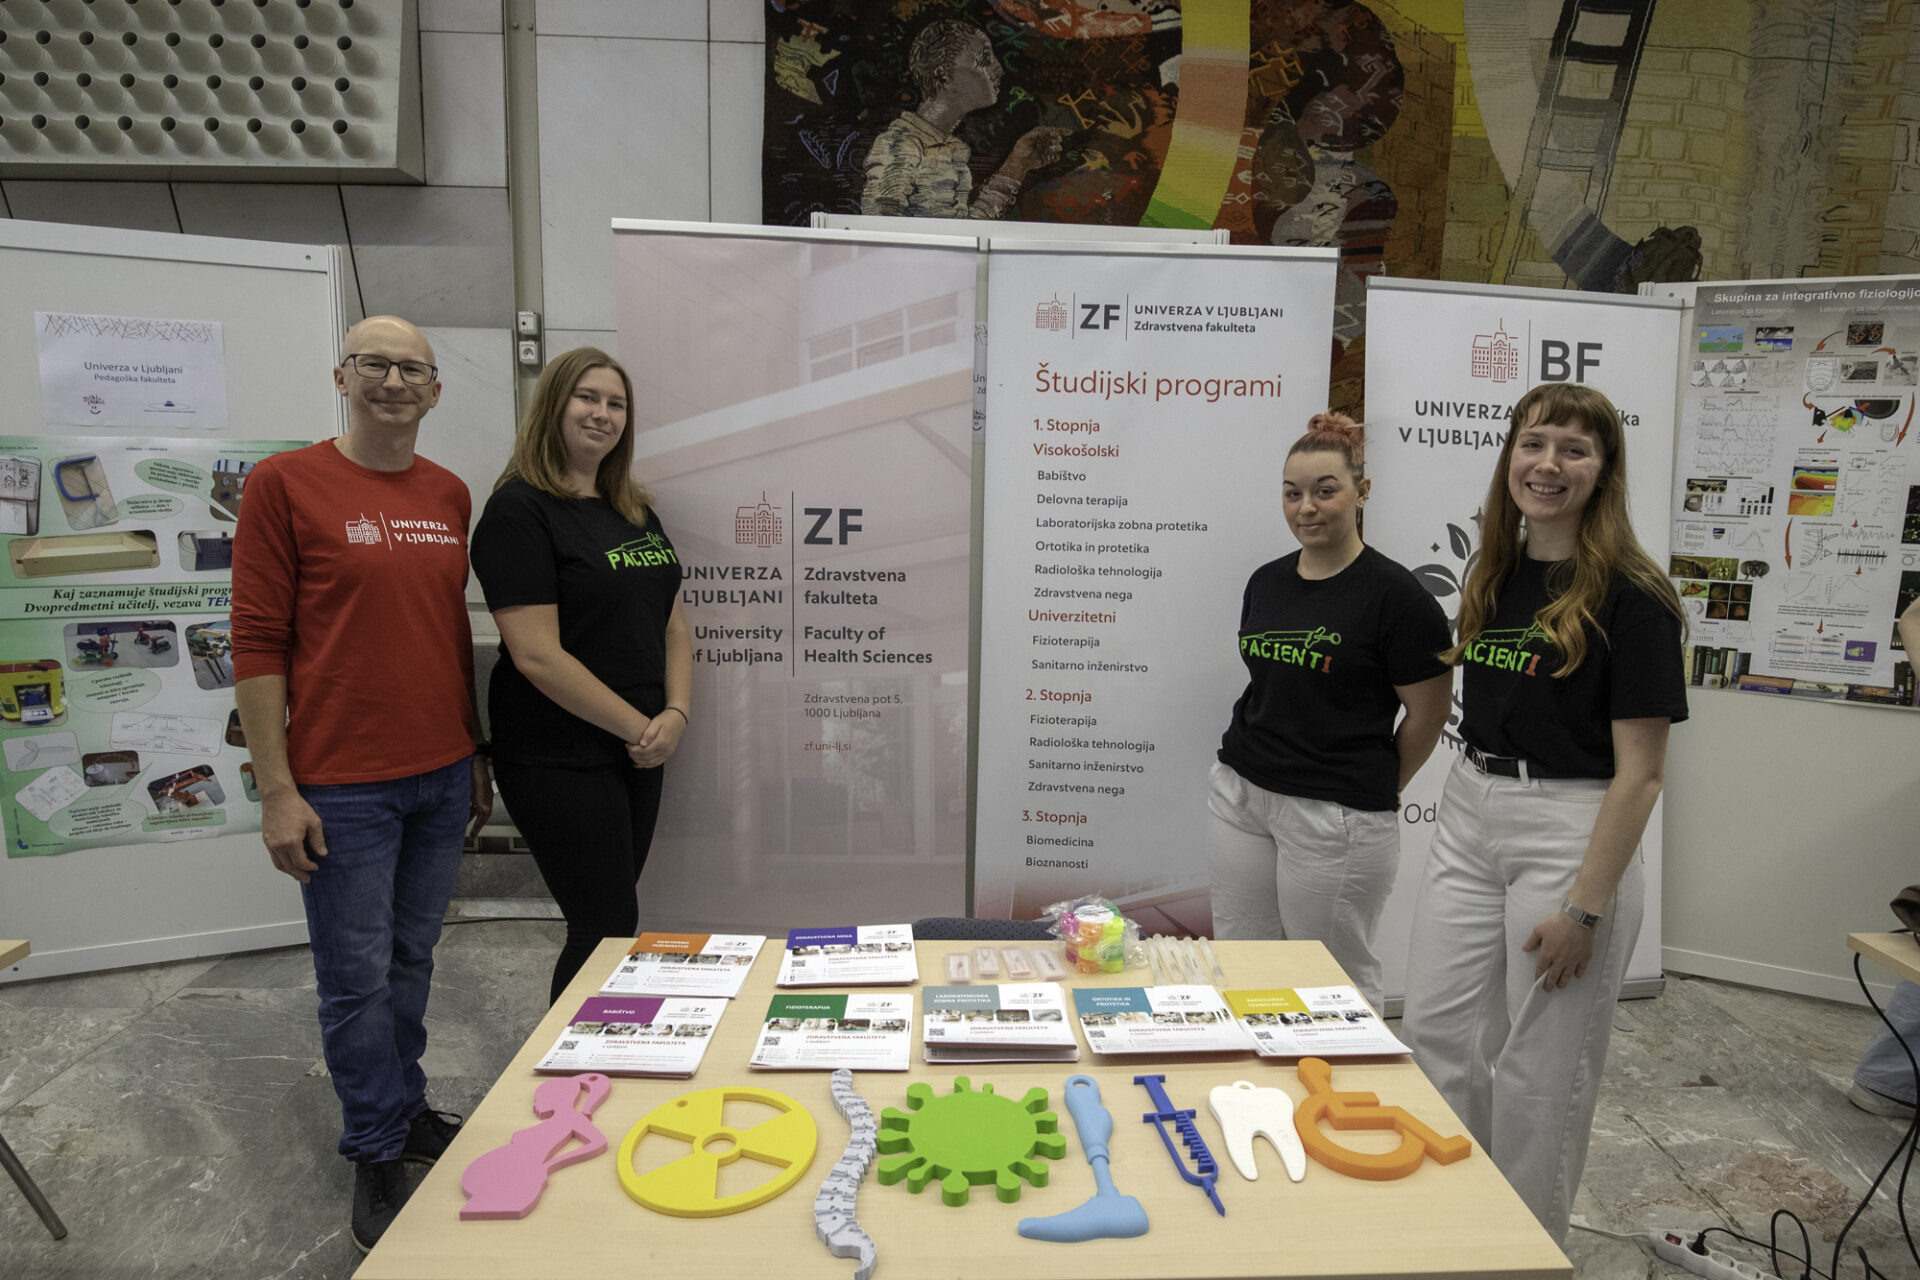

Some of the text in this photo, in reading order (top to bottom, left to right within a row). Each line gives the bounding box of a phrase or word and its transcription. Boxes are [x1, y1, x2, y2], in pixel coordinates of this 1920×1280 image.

[1714, 292, 1762, 305] Skupina
[1765, 293, 1779, 302] za
[1782, 290, 1857, 303] integrativno
[1080, 304, 1121, 330] ZF
[1134, 305, 1284, 319] UNIVERZA V LJUBLJANI
[1134, 320, 1256, 333] Zdravstvena fakulteta
[84, 361, 130, 373] Univerza
[141, 364, 184, 375] Ljubljani
[1540, 339, 1603, 384] BF
[94, 373, 176, 384] Pedagoška fakulteta
[1036, 362, 1282, 403] Študijski programi
[1415, 400, 1514, 420] UNIVERZA
[1033, 419, 1101, 435] 1. Stopnja
[1398, 427, 1508, 450] V LJUBLJAN
[1033, 443, 1120, 458] Visokošolski
[1037, 470, 1087, 482] Babištvo
[1036, 494, 1129, 508] Delovna terapija
[390, 519, 450, 532] UNIVERZA
[803, 507, 864, 546] ZF
[1036, 518, 1208, 534] Laboratorijska zobna protetika
[394, 533, 460, 546] V LJUBLJANI
[1035, 541, 1150, 556] Ortotika in protetika
[681, 566, 783, 580] UNIVERZA
[803, 567, 907, 583] Zdravstvena
[1034, 565, 1163, 580] Radiološka tehnologija
[53, 588, 76, 601] Kaj
[79, 587, 146, 600] zaznamuje
[149, 585, 199, 597] študijski
[683, 590, 783, 608] LJUBLJANI
[803, 590, 878, 606] fakulteta
[1034, 588, 1133, 602] Zdravstvena nega
[24, 600, 115, 615] Dvopredmetni
[118, 599, 160, 612] učitelj,
[163, 600, 202, 609] vezava
[1028, 609, 1117, 624] Univerzitetni
[695, 625, 783, 643] University
[803, 626, 886, 644] Faculty of
[1032, 635, 1100, 649] Fizioterapija
[692, 648, 783, 666] f Ljubljana
[803, 649, 933, 664] Health Sciences
[1240, 638, 1334, 675] PACIENTI
[1463, 641, 1542, 677] ACIENTI
[1031, 659, 1149, 673] Sanitarno inženirstvo
[803, 693, 870, 704] Zdravstvena
[872, 694, 891, 706] pot
[1025, 689, 1092, 705] 2. Stopnja
[804, 708, 881, 719] 1000 Ljubljana
[1030, 714, 1098, 728] Fizioterapija
[803, 741, 852, 752] zf.uni-lj.si
[1029, 737, 1155, 753] Radiološka tehnologija
[1028, 759, 1145, 774] Sanitarno inženirstvo
[1028, 781, 1125, 797] Zdravstvena nega
[1022, 810, 1088, 826] 3. Stopnja
[1404, 801, 1437, 824] Od
[1026, 834, 1095, 848] Biomedicina
[1025, 856, 1089, 870] Bioznanosti
